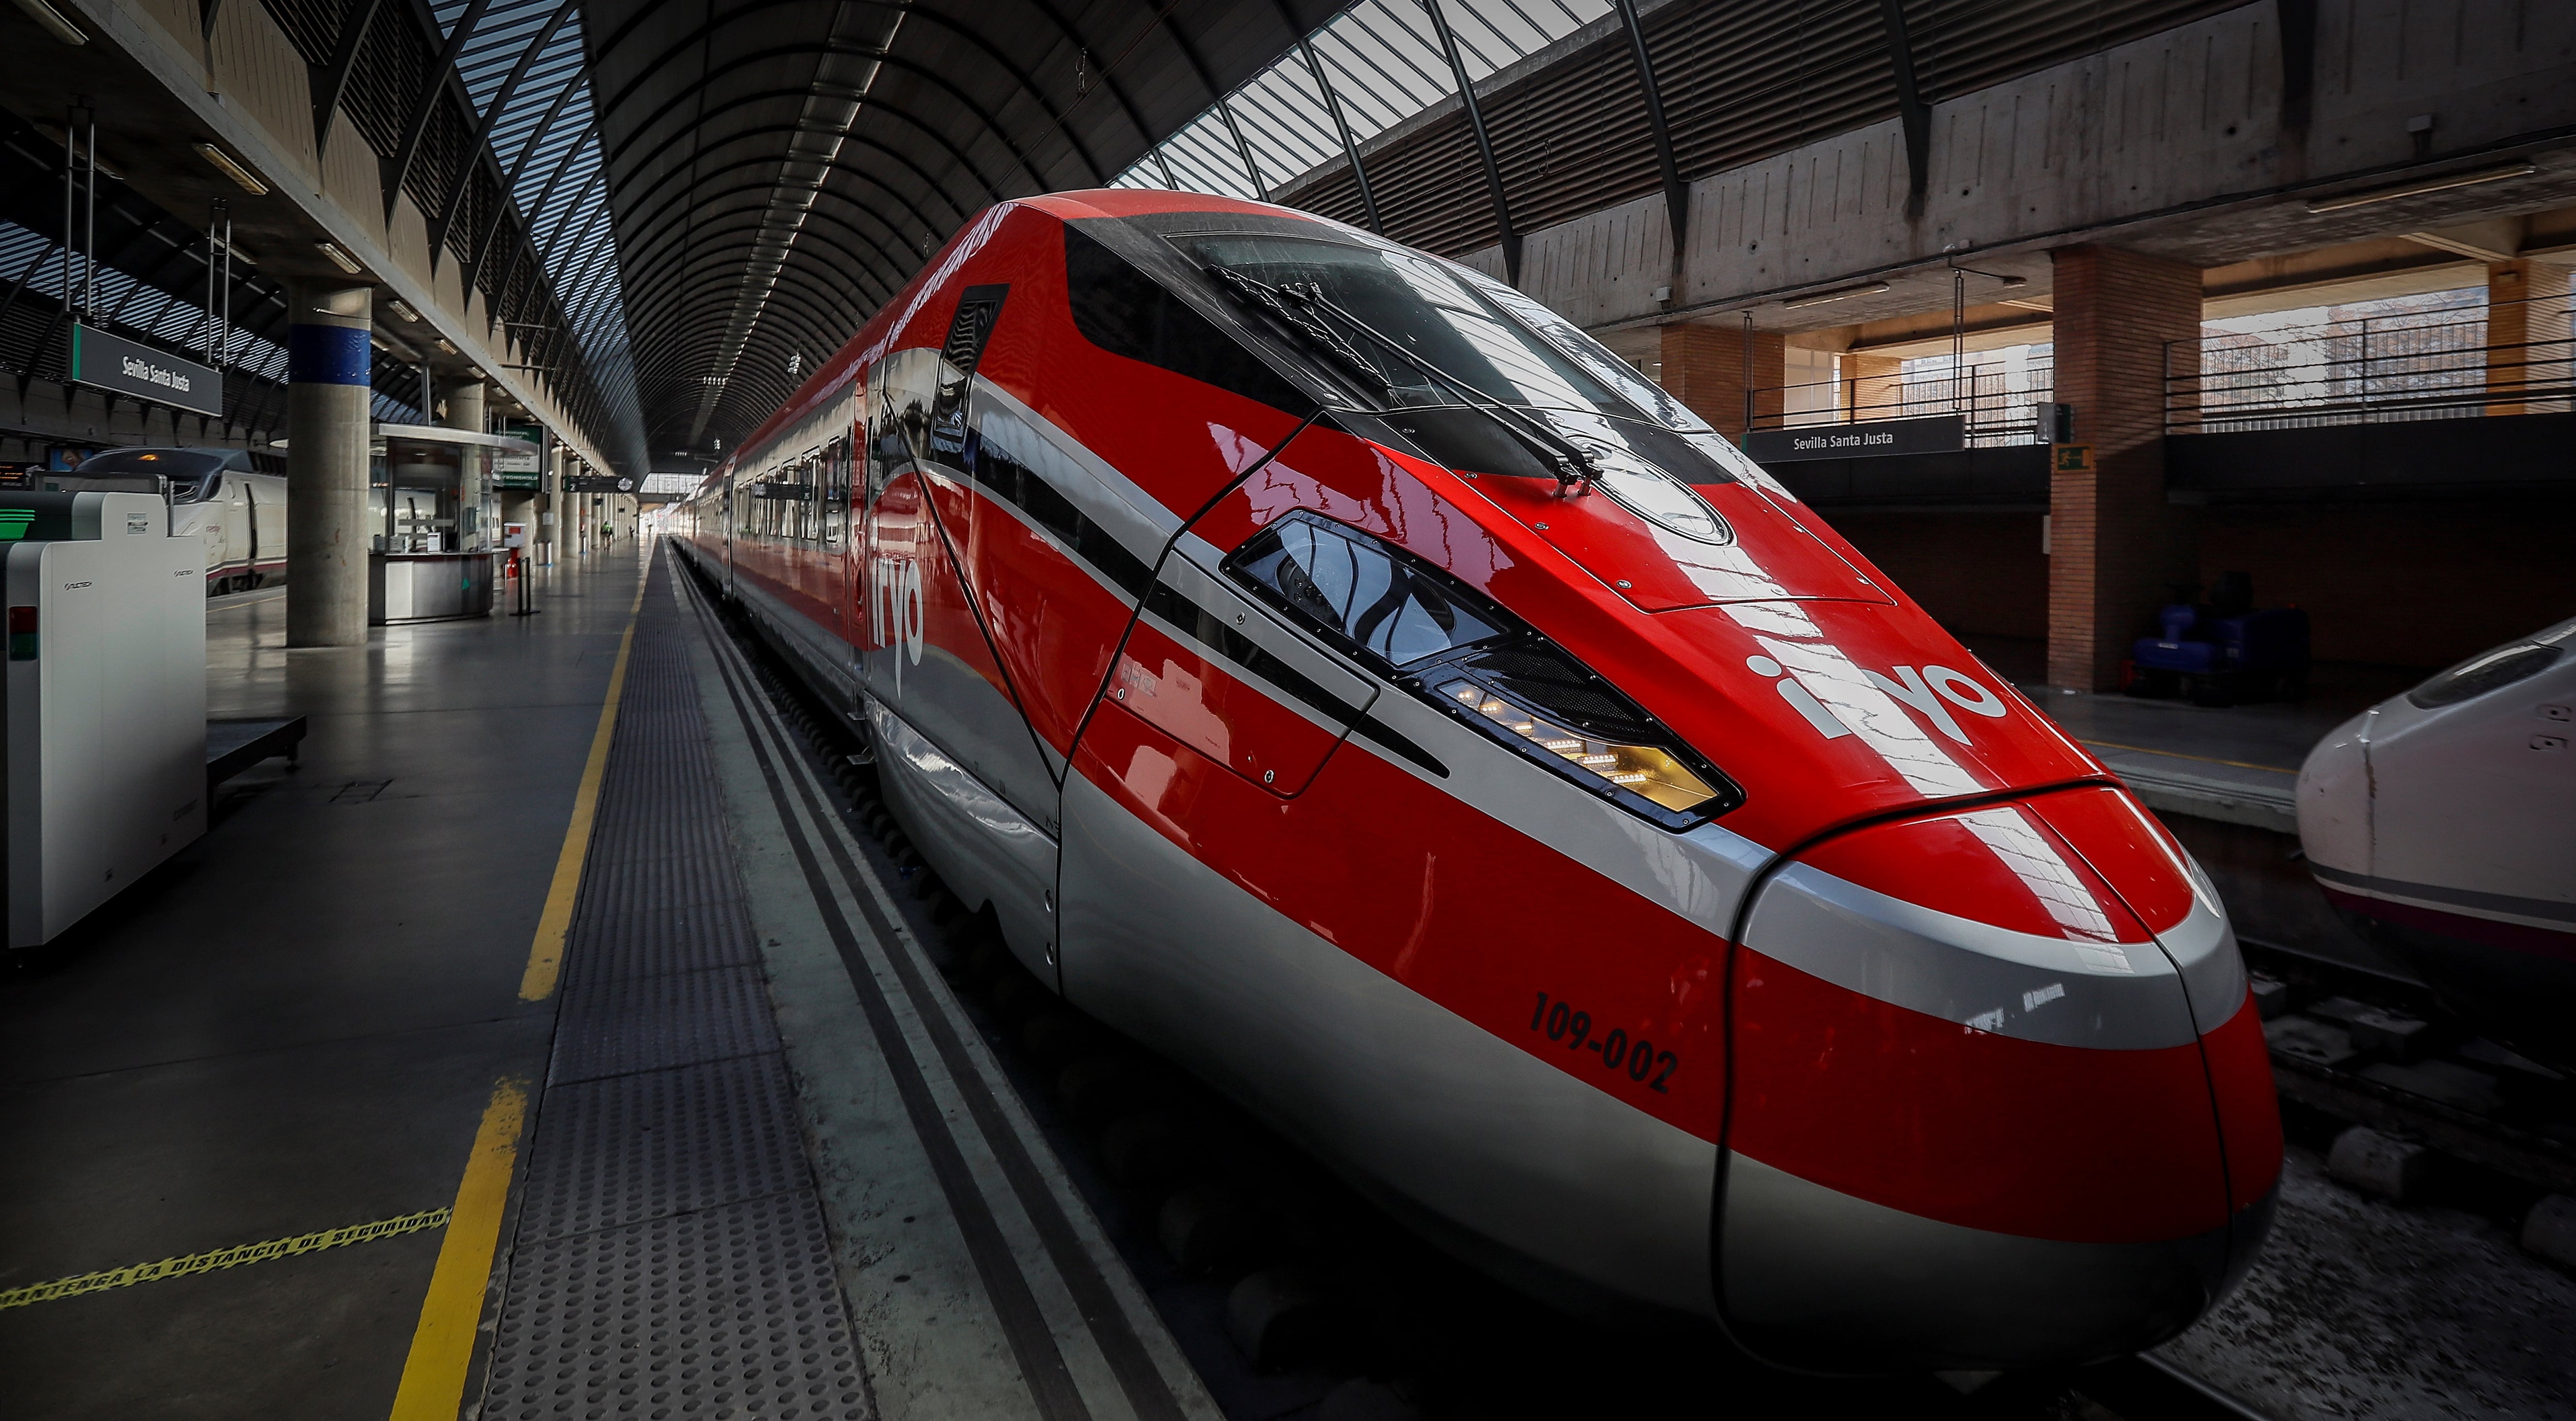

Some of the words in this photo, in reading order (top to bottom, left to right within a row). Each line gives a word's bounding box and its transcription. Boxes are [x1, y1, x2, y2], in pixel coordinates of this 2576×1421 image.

[123, 356, 149, 380] Sevilla
[150, 364, 171, 386] Santa
[172, 371, 190, 392] Justa
[1794, 436, 1827, 450] Sevilla
[1830, 435, 1860, 447] Santa
[1863, 432, 1893, 445] Justa
[1746, 655, 2007, 747] iyo
[1530, 991, 1677, 1095] 109-002
[134, 1266, 161, 1279] LA
[171, 1243, 289, 1273] DISTANCIA
[298, 1237, 325, 1248] DE
[332, 1214, 444, 1241] SEGURIDAD
